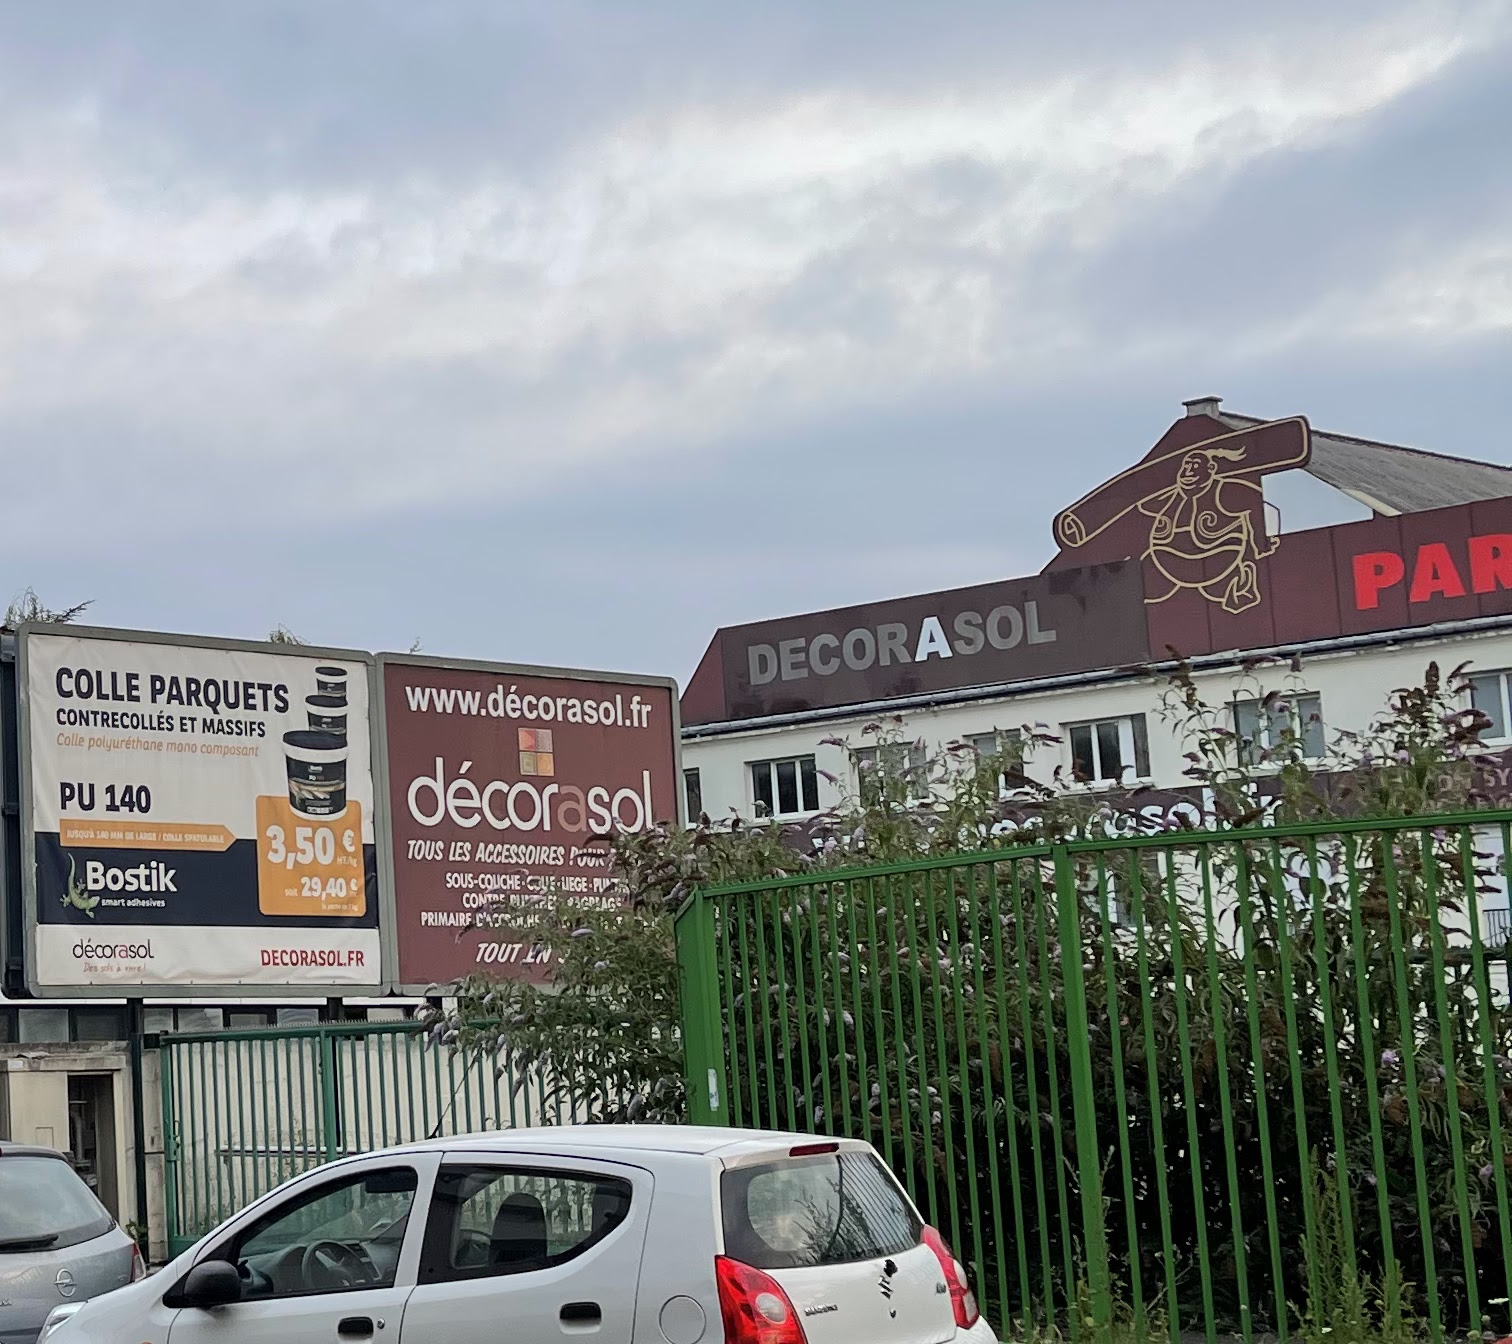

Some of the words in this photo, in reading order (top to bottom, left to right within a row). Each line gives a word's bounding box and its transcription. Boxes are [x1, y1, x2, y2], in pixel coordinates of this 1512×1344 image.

[1353, 533, 1512, 610] PAR
[748, 601, 1057, 686] DECORASOL
[56, 667, 141, 704] COLLE
[149, 674, 290, 715] PARQUETS
[404, 684, 653, 728] www.décorasol.fr
[56, 708, 175, 732] CONTRECOLLÉS
[179, 717, 197, 733] ET
[202, 718, 266, 738] MASSIFS
[56, 733, 85, 747] Colle
[88, 734, 163, 752] polyuréthane
[166, 741, 198, 754] mono
[200, 745, 259, 758] composant
[59, 782, 96, 811] PU
[105, 784, 151, 814] 140
[407, 757, 654, 835] décorasol
[266, 824, 335, 870] 3,50
[342, 829, 356, 853] €
[407, 840, 445, 861] TOUS
[448, 842, 472, 862] LES
[475, 843, 565, 866] ACCESSOIRES
[86, 860, 178, 893] Bostik
[300, 876, 347, 901] 29,40
[446, 872, 521, 891] SOUS-COUCHE
[101, 898, 125, 907] smart
[126, 898, 166, 908] adhesives
[72, 937, 155, 959] décorasol
[261, 949, 365, 968] DECORASOL.FR
[476, 943, 522, 963] TOUT
